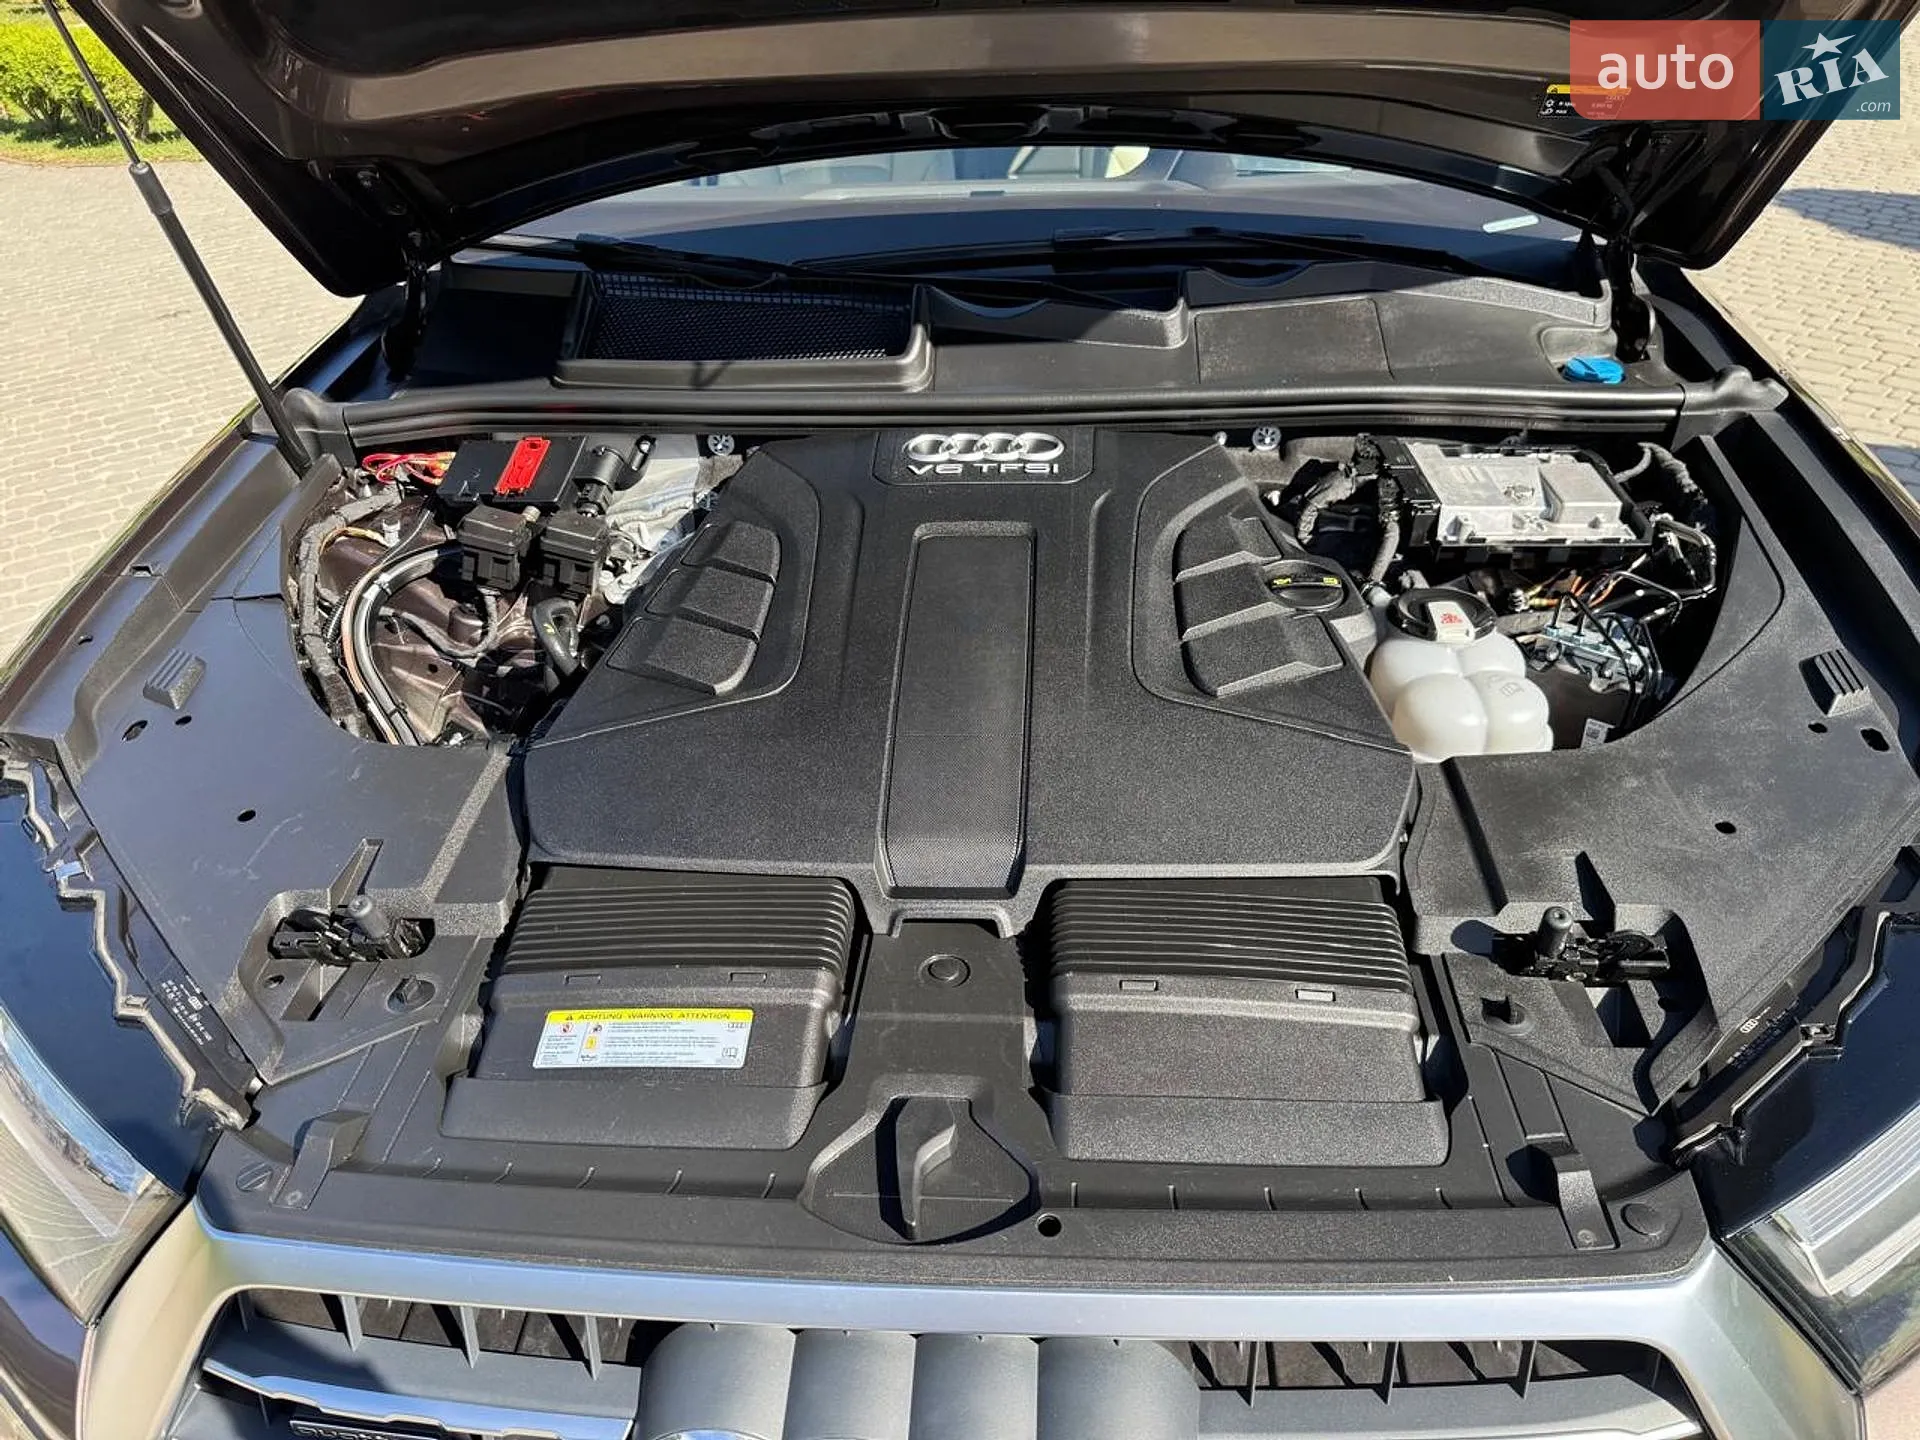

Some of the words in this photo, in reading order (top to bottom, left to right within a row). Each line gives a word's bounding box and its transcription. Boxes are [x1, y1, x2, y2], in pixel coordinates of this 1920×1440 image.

[906, 463, 963, 475] V6
[972, 463, 1059, 475] TFSI
[578, 1012, 622, 1020] ACHTUNG
[627, 1012, 673, 1020] WARNING
[678, 1012, 731, 1020] ATTENTION
